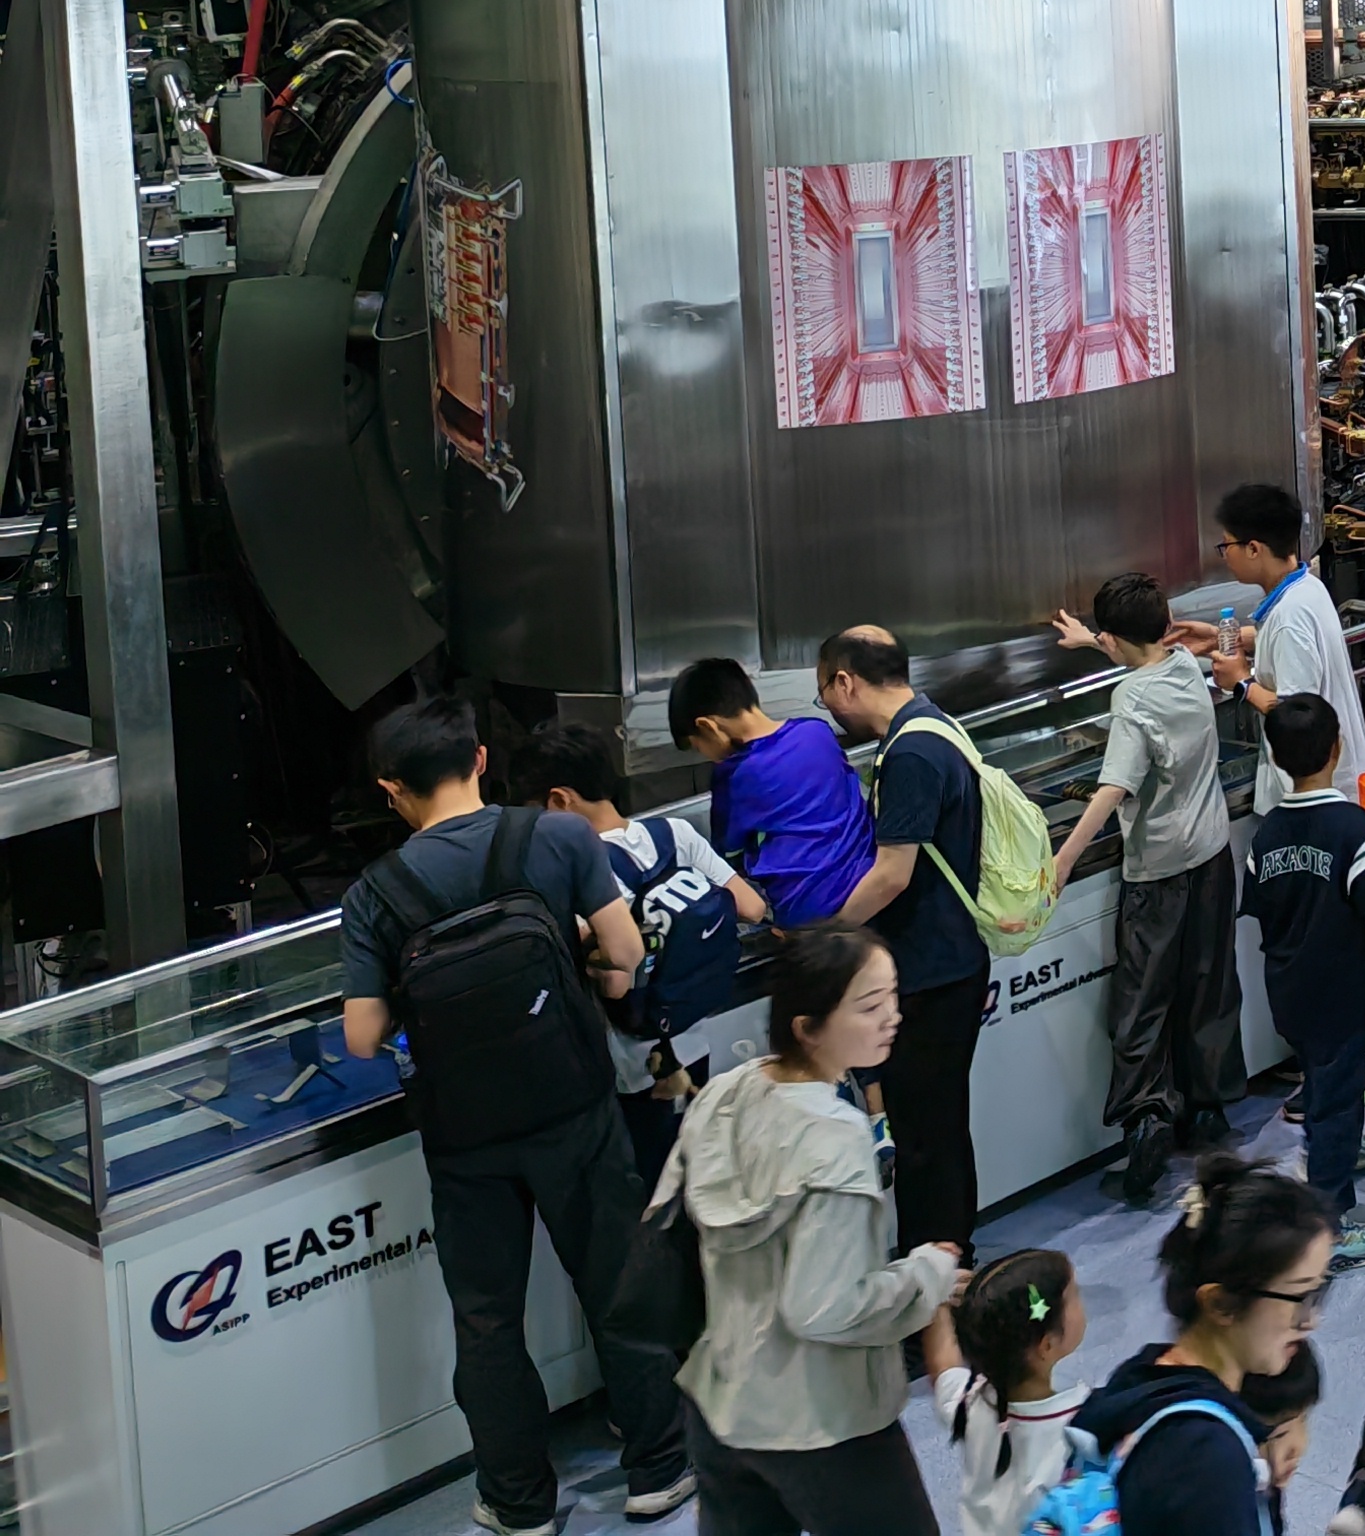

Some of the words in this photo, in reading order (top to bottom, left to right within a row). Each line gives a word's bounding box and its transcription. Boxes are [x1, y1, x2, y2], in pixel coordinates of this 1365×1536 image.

[1010, 958, 1064, 998] EAST
[264, 1201, 382, 1278] EAST
[267, 1235, 412, 1309] Experimental
[212, 1313, 250, 1336] ASIPP
